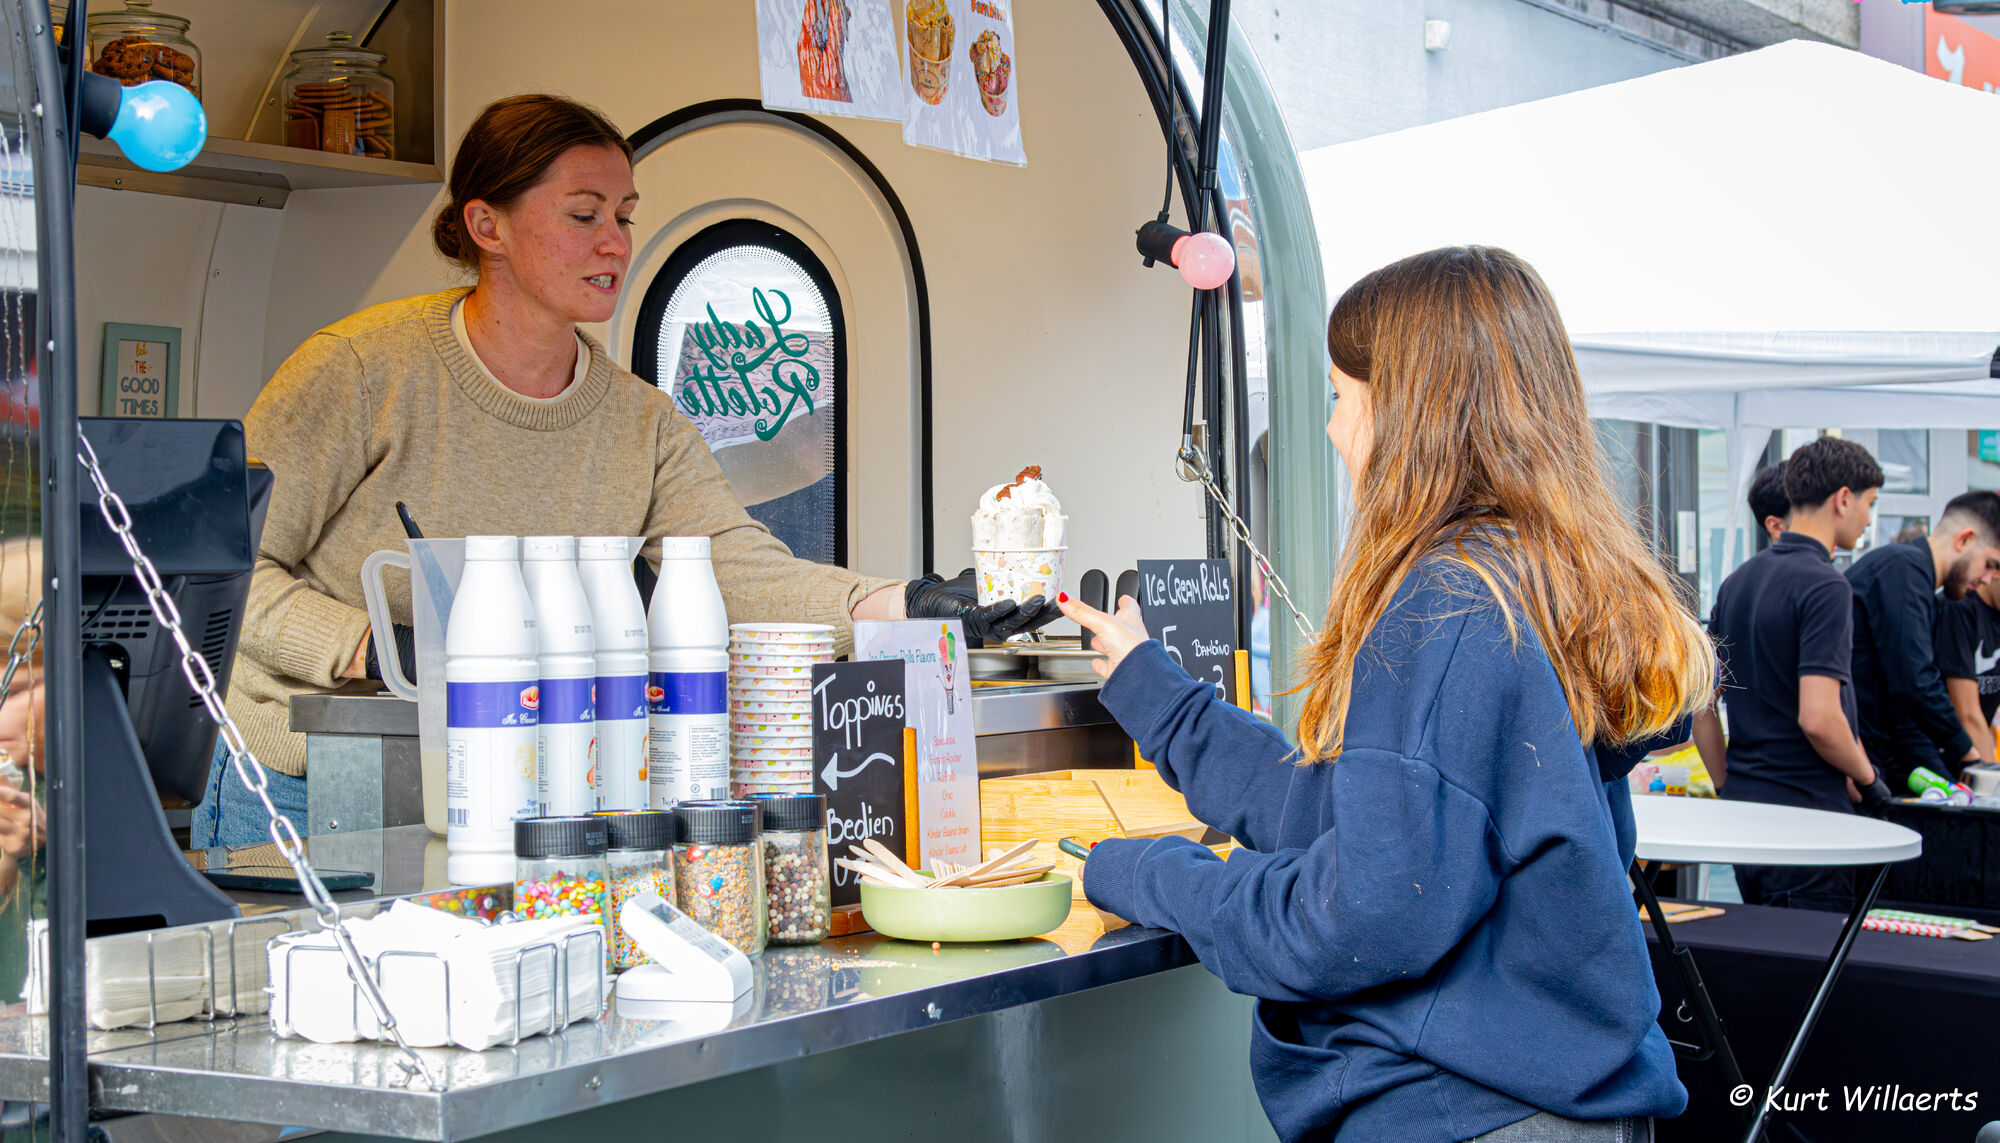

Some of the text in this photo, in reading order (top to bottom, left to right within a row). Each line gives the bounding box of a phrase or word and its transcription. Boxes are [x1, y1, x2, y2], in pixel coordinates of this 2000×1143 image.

[135, 360, 147, 374] THE
[120, 376, 160, 394] GOOD
[120, 398, 158, 415] TIMES
[826, 802, 893, 845] Bedien
